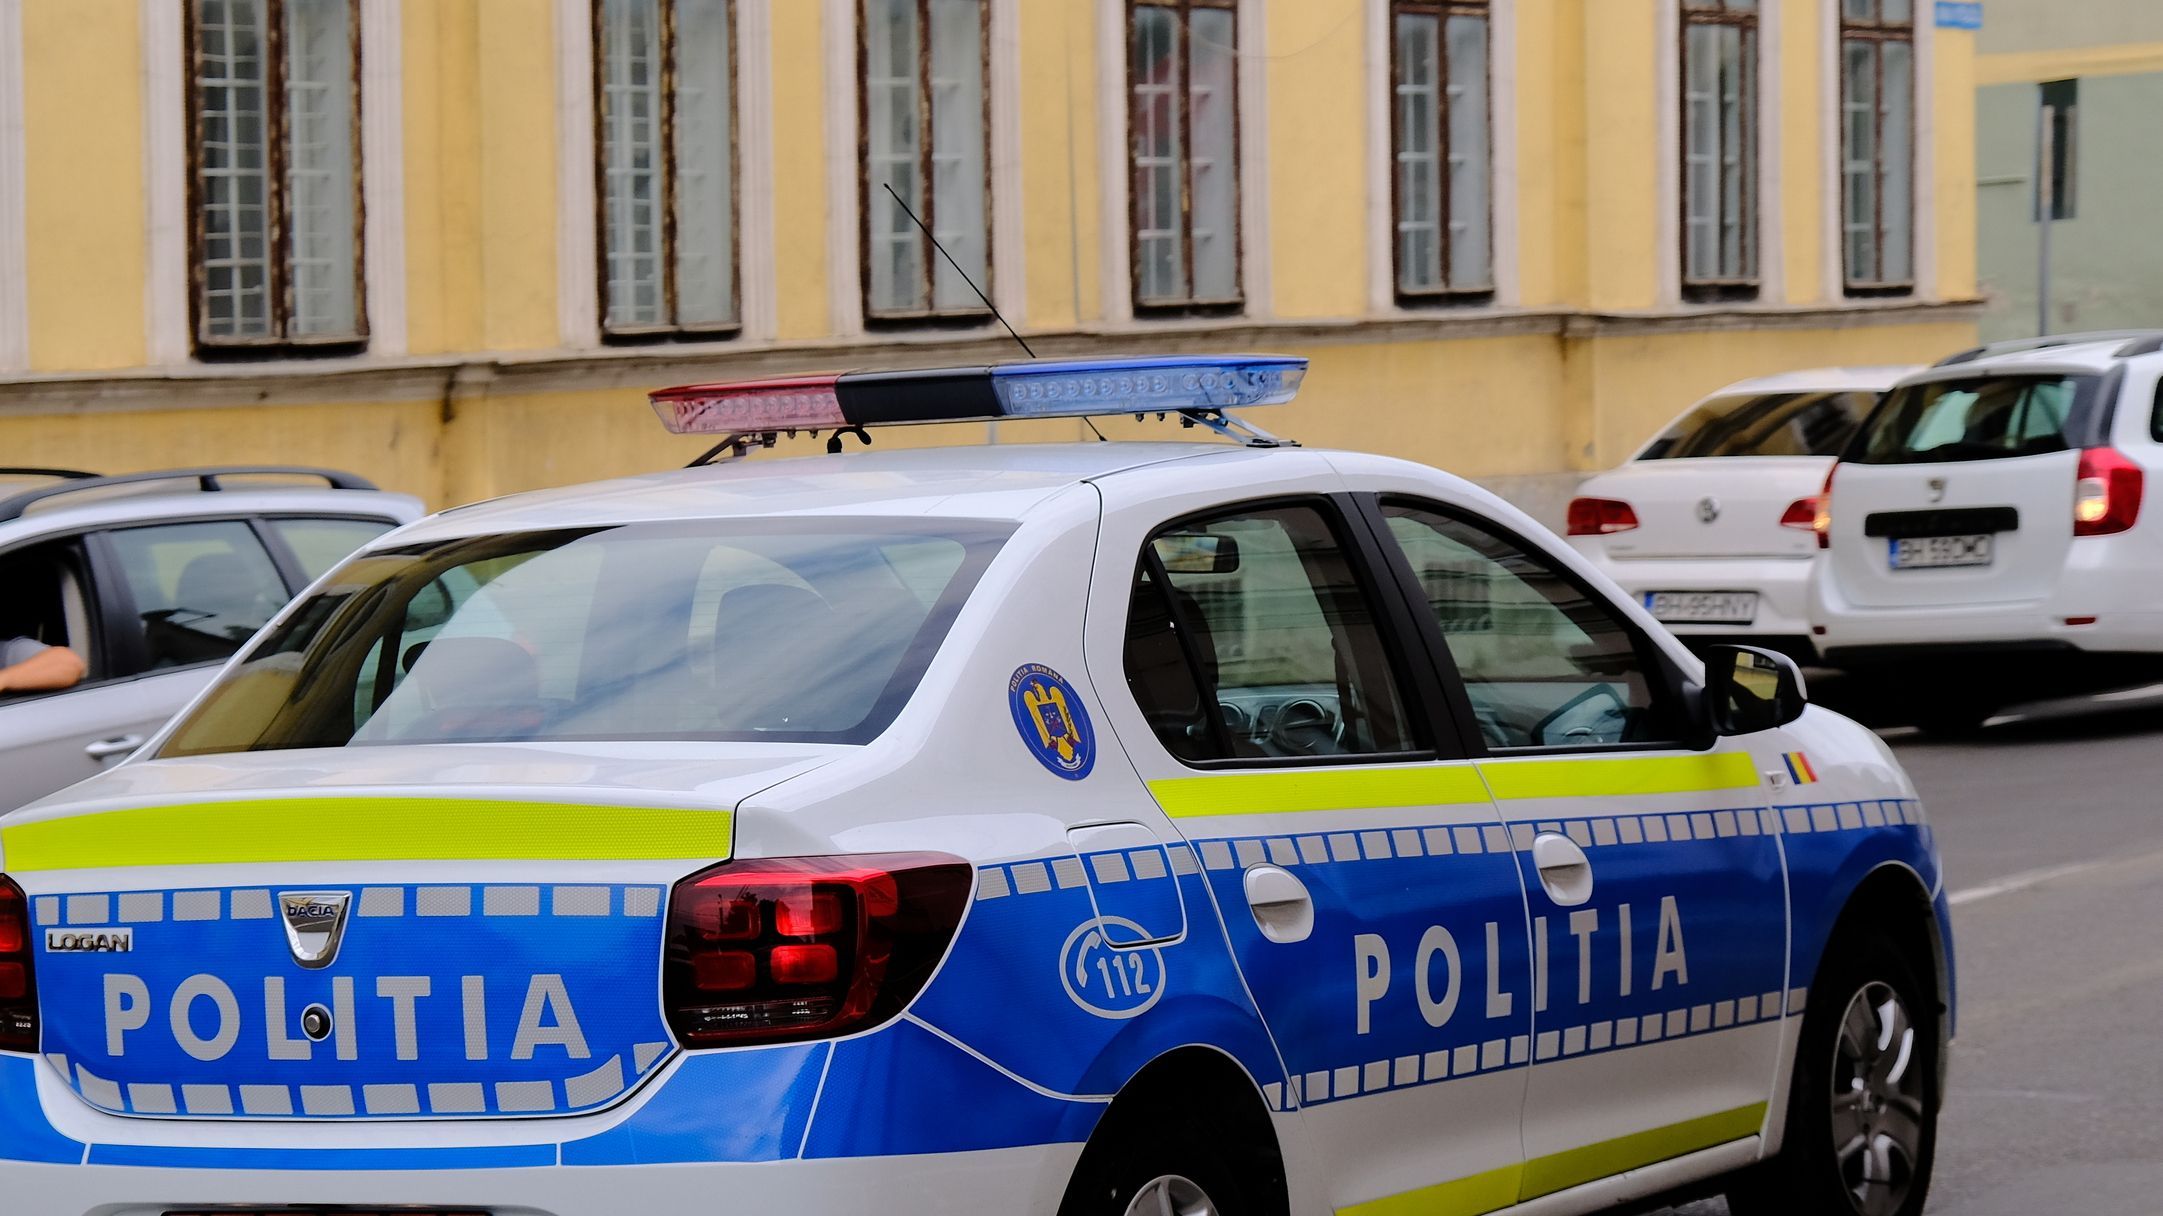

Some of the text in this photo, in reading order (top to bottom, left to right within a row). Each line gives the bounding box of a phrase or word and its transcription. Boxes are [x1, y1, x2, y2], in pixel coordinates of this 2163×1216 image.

[1010, 667, 1028, 692] POLITIA
[288, 904, 335, 918] DACIA
[47, 932, 130, 952] LOGAN
[1096, 952, 1151, 998] 112
[1354, 895, 1688, 1035] POLITIA
[103, 973, 592, 1061] POLITIA
